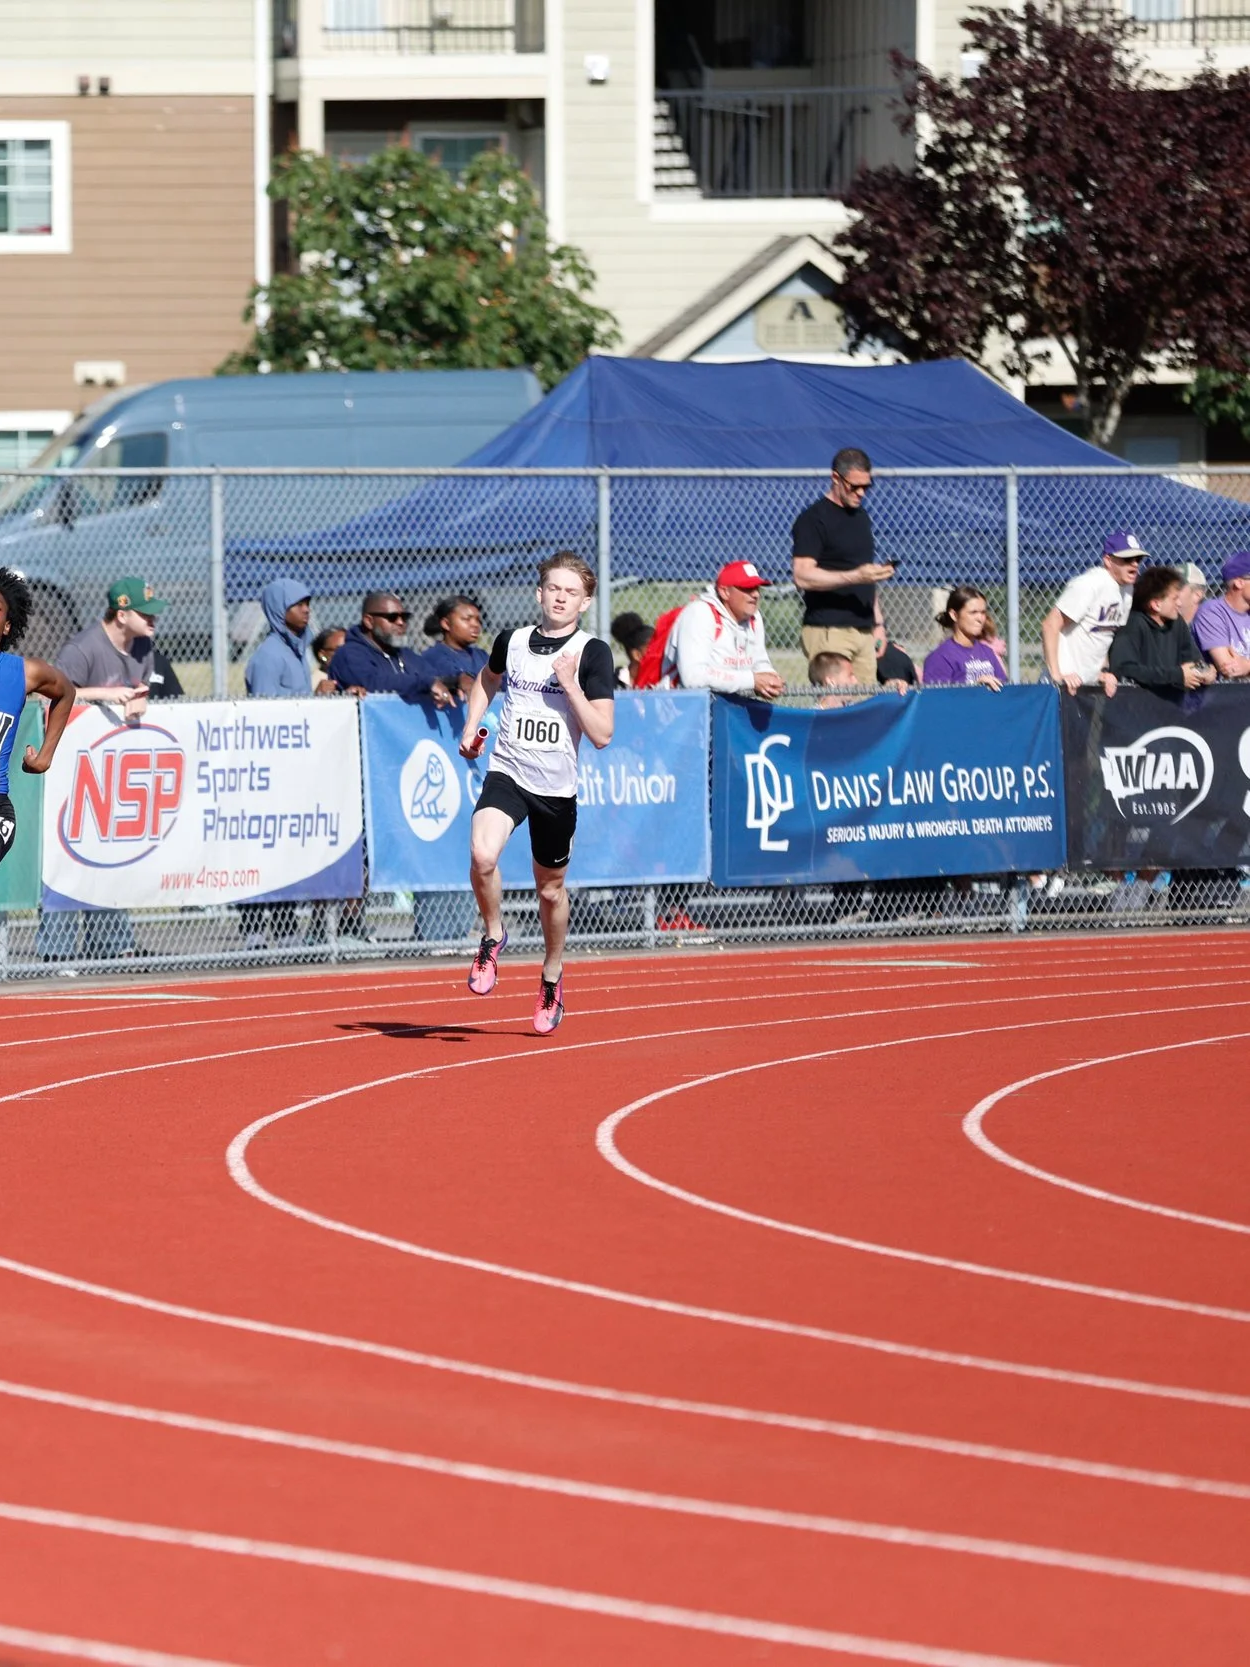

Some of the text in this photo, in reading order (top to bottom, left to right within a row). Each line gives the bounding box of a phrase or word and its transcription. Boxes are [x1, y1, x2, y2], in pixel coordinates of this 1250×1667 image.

[197, 716, 311, 751] Northwest
[515, 717, 560, 744] 1060
[197, 760, 271, 802] Sports
[609, 763, 676, 806] Union
[1114, 752, 1199, 790] WIAA
[68, 748, 186, 843] NSP
[203, 803, 340, 848] Photography
[826, 815, 1053, 844] SERIOUS INJURY & WRONGFUL DEATH ATTORNEYS
[160, 865, 260, 891] www.4nsp.com
